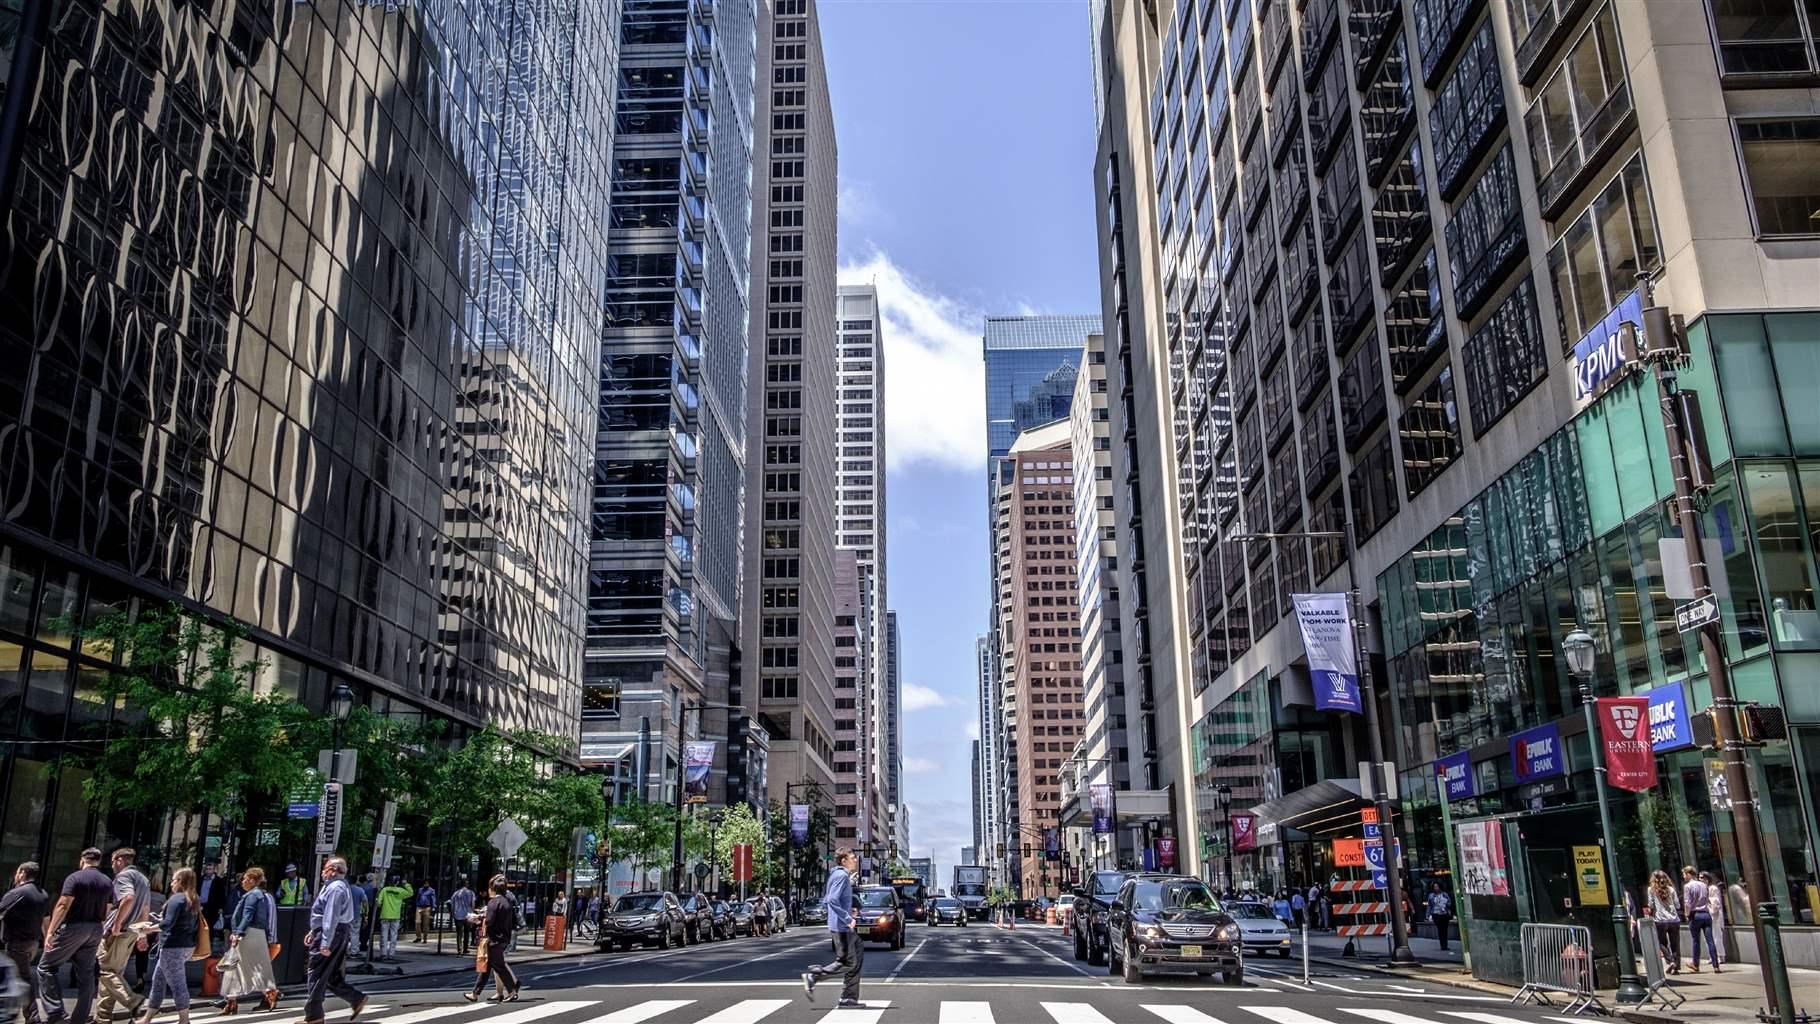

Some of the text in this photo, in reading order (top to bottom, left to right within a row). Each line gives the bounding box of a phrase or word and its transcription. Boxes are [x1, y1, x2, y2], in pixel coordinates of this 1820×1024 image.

[1680, 605, 1705, 624] ONE WAY
[1649, 700, 1675, 726] UBLIC
[1651, 723, 1677, 744] BANK
[1608, 740, 1651, 750] EASTERN
[1534, 757, 1553, 774] BANK
[1451, 780, 1466, 794] BANK
[1364, 811, 1377, 821] DET
[1368, 825, 1381, 835] EA
[1369, 847, 1385, 863] 67
[1576, 857, 1601, 865] TODAY!
